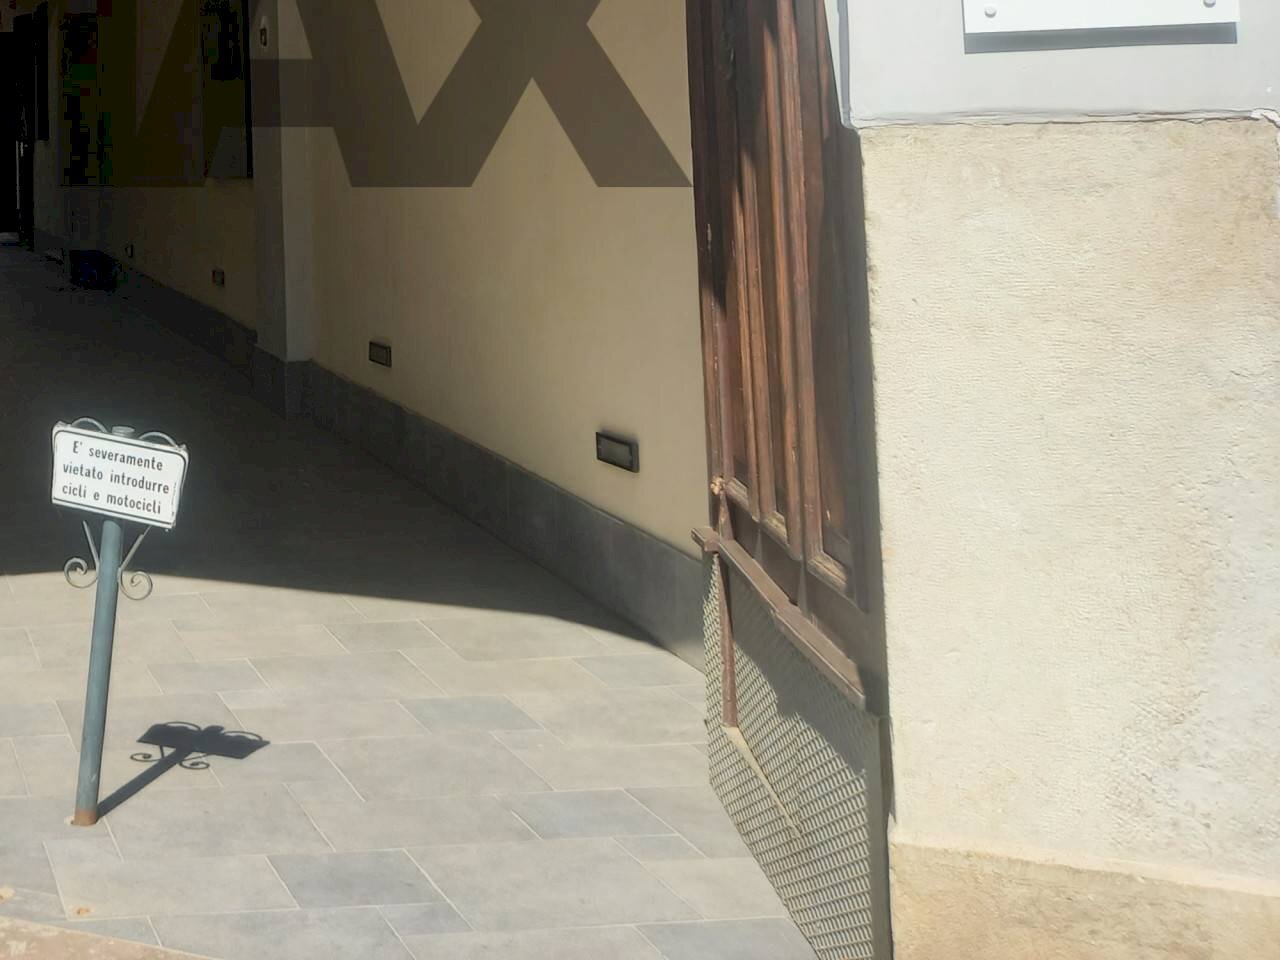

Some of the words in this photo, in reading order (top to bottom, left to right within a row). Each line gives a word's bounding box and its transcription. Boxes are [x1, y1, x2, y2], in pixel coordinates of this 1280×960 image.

[88, 446, 164, 471] severamente
[63, 461, 104, 480] vietato
[109, 470, 170, 494] introdurre
[62, 483, 88, 499] cicli
[93, 490, 100, 501] e
[106, 491, 162, 514] motocicli
